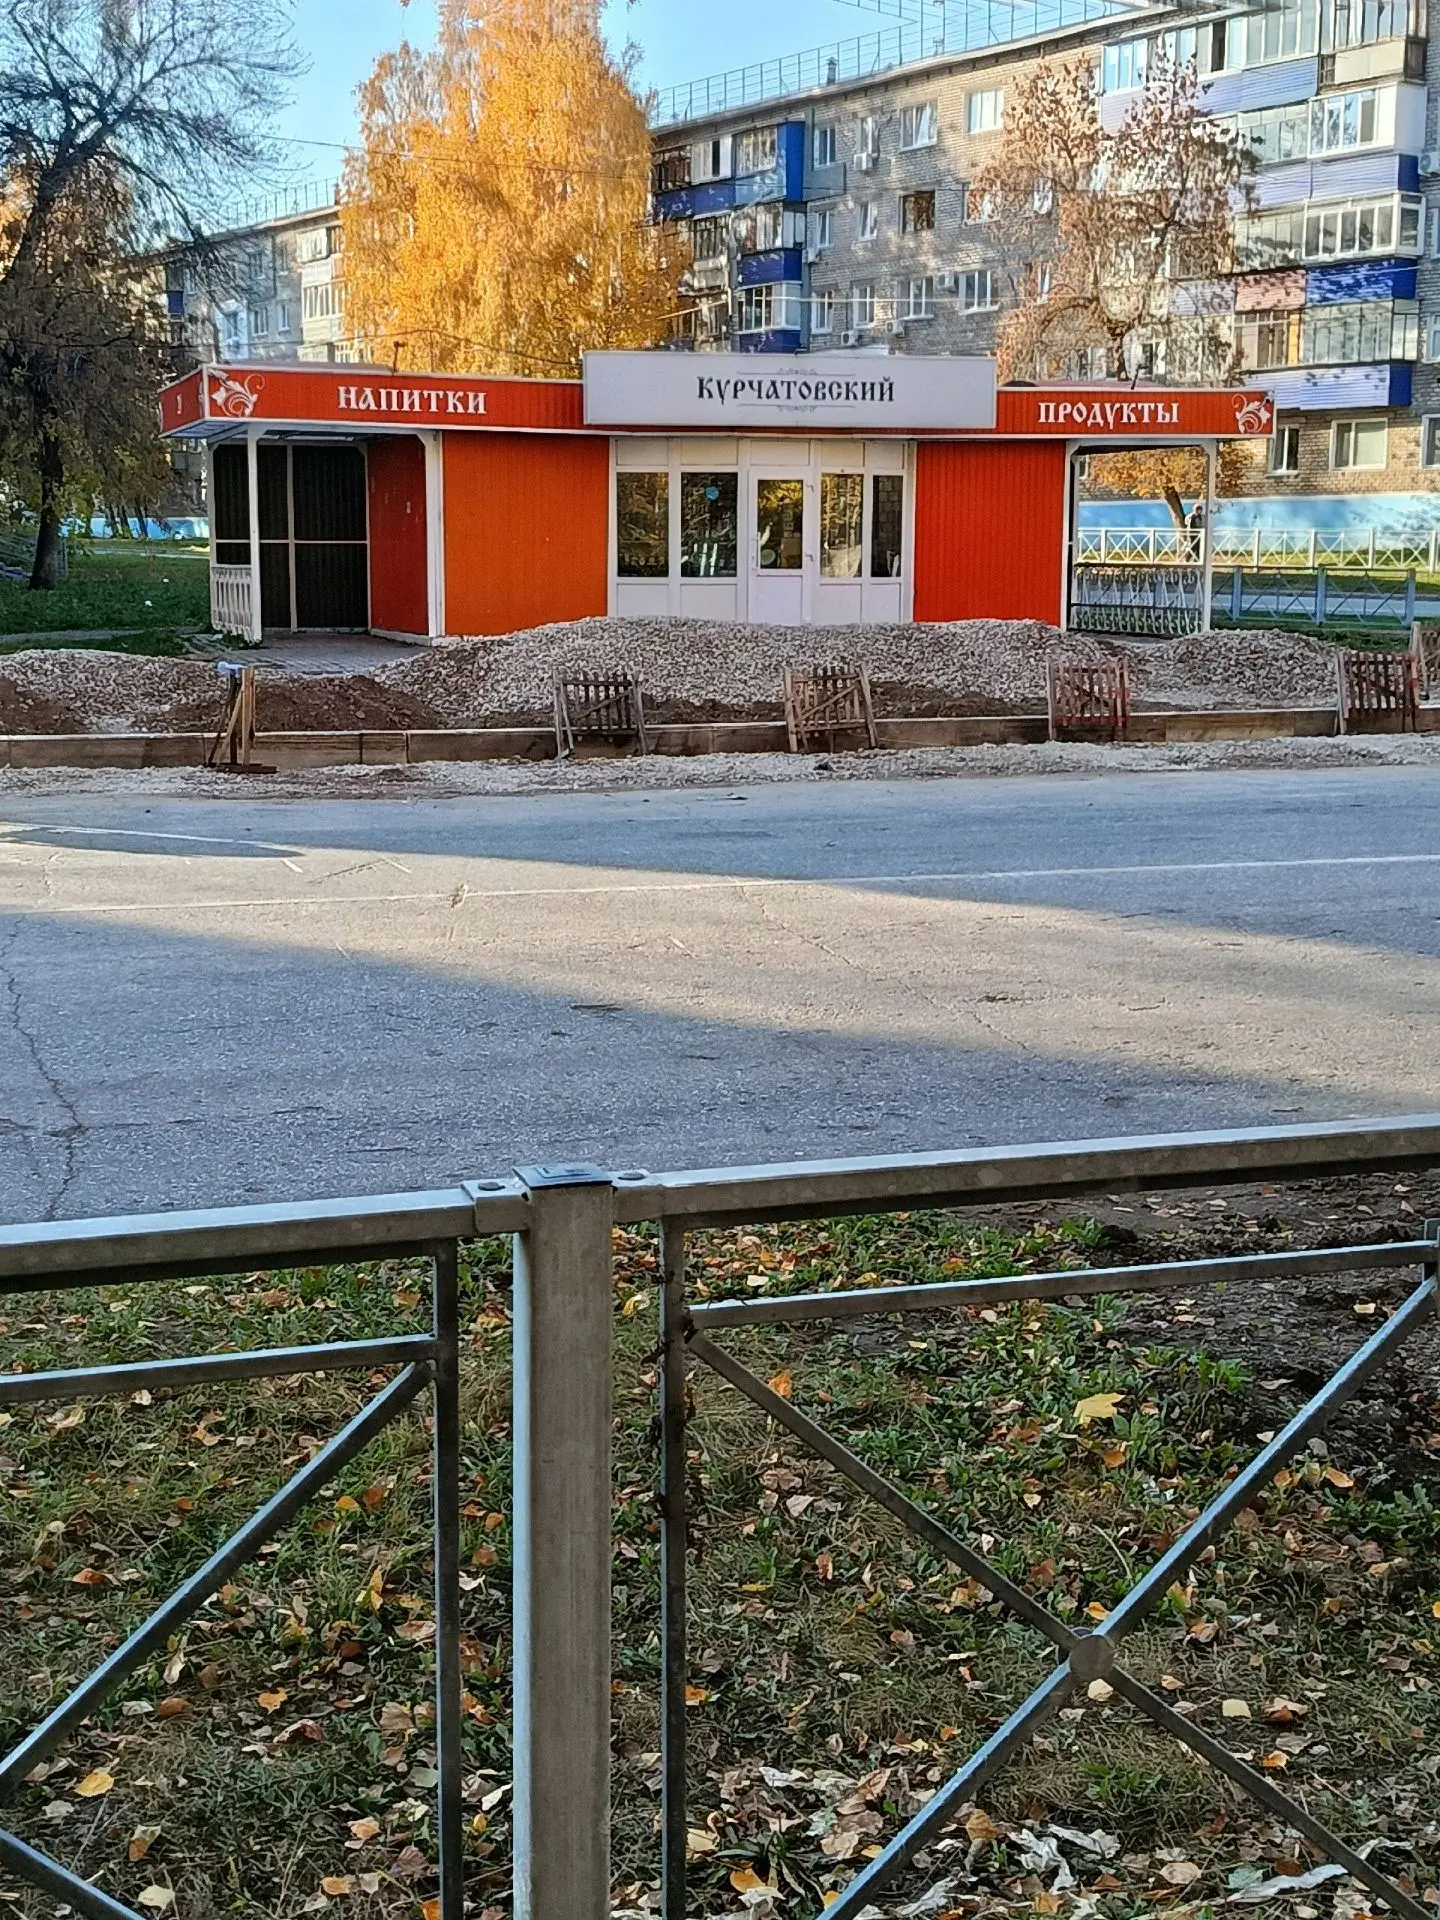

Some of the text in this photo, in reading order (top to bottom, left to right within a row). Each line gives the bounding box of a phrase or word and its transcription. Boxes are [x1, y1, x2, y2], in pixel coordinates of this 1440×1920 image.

[337, 386, 487, 414] НАПИТКИ
[696, 376, 895, 406] КУРЧАТОВСКИЙ
[1038, 401, 1180, 430] ПРОДУКТЫ
